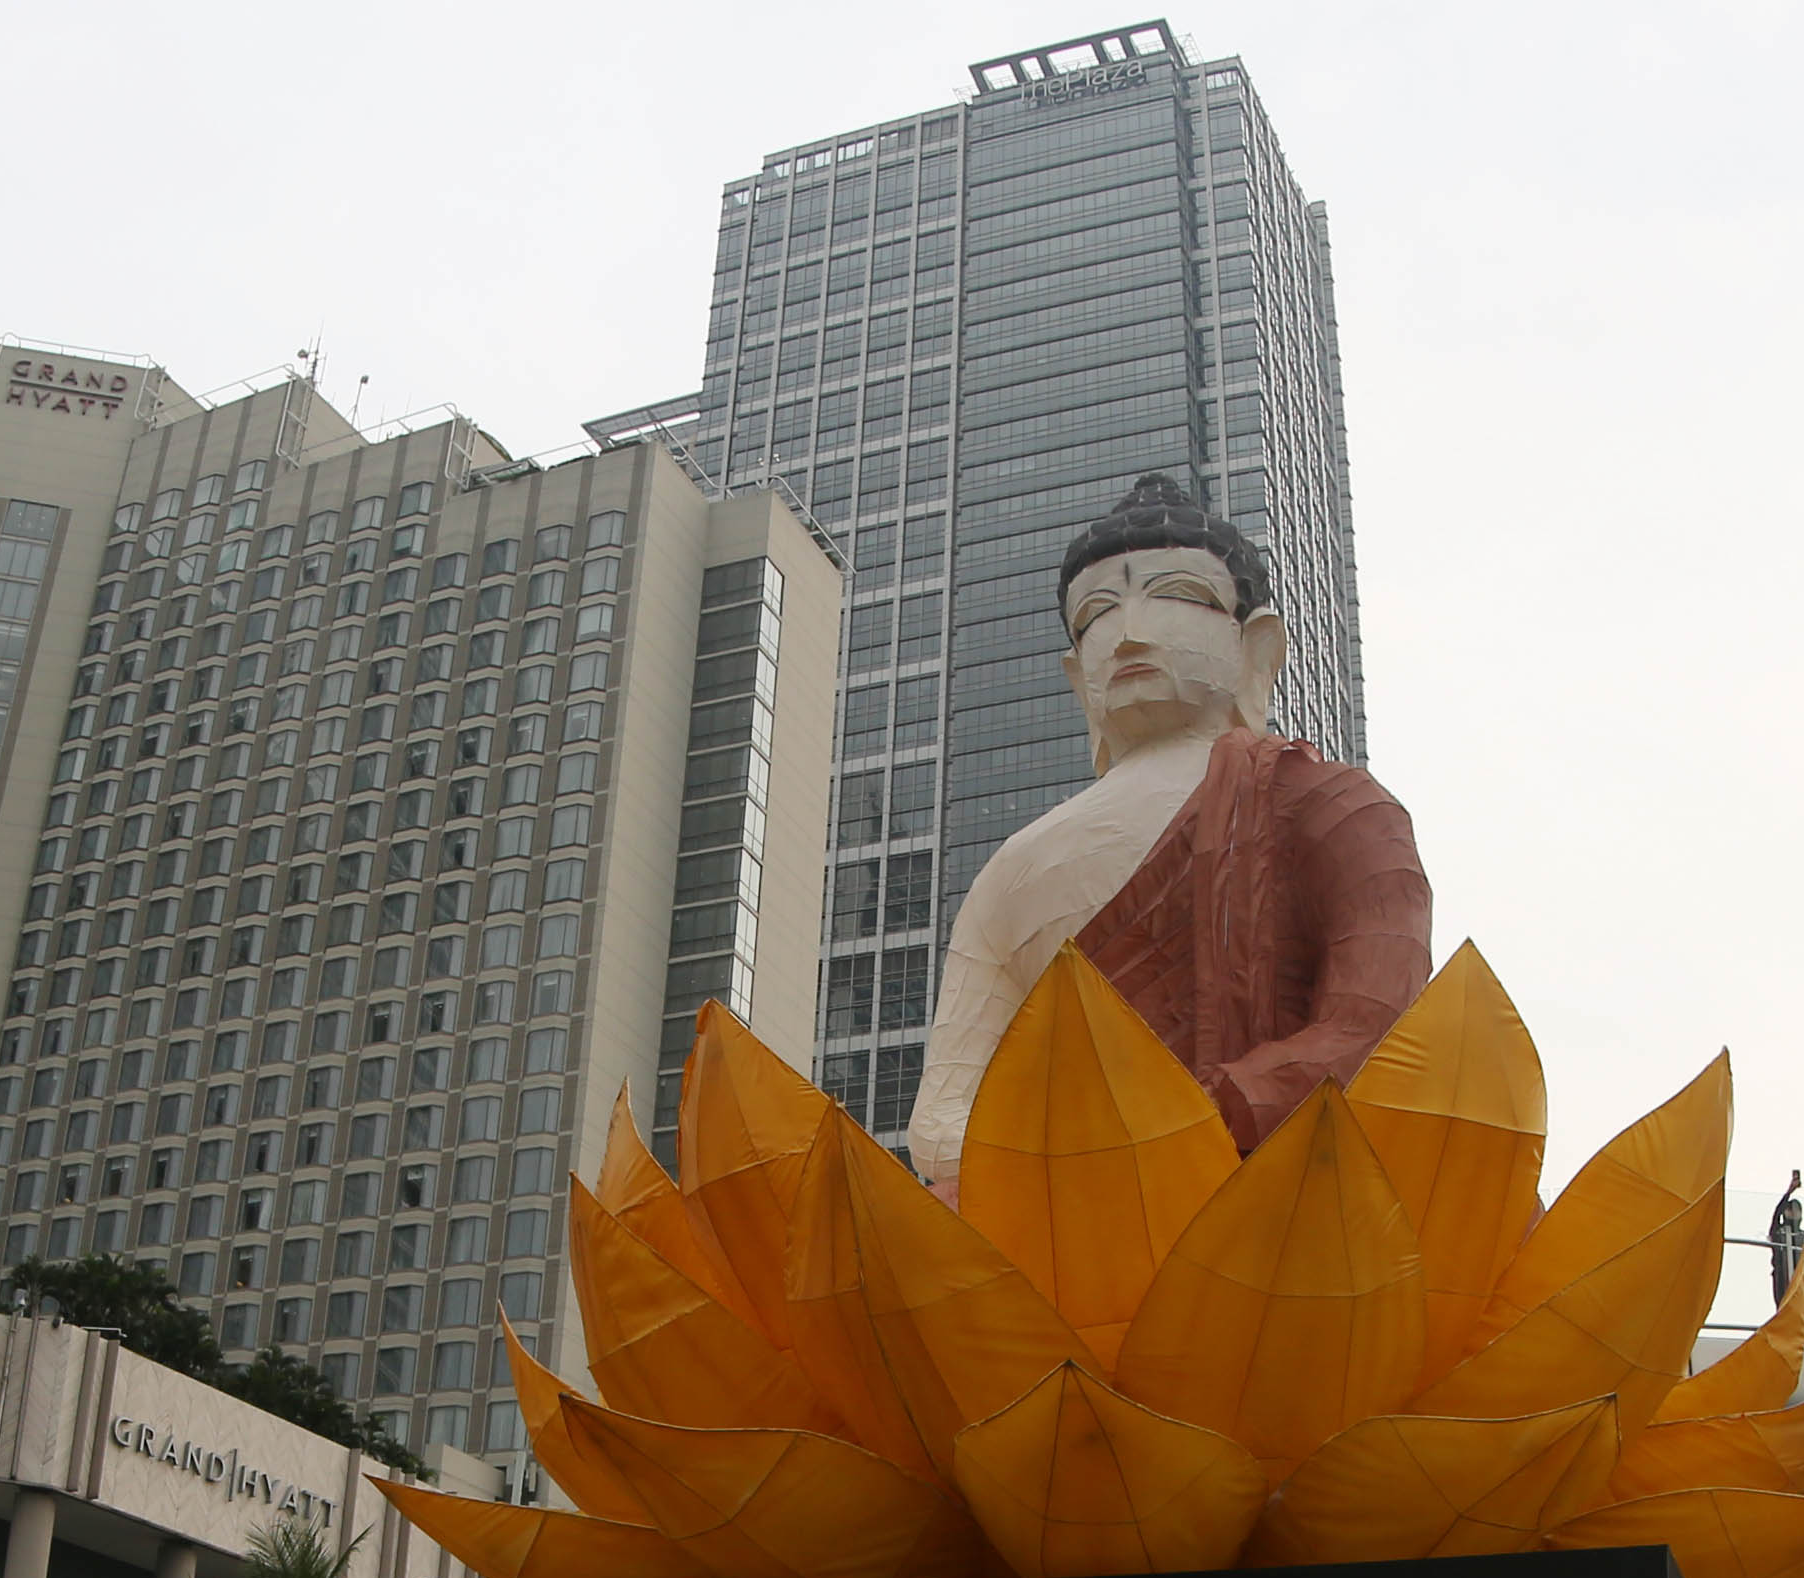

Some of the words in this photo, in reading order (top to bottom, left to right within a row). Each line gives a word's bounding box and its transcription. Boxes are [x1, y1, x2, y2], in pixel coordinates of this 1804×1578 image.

[12, 360, 128, 393] GRAND
[6, 387, 119, 420] HYATT
[112, 1416, 226, 1483] GRAND
[238, 1464, 339, 1528] HYATT
